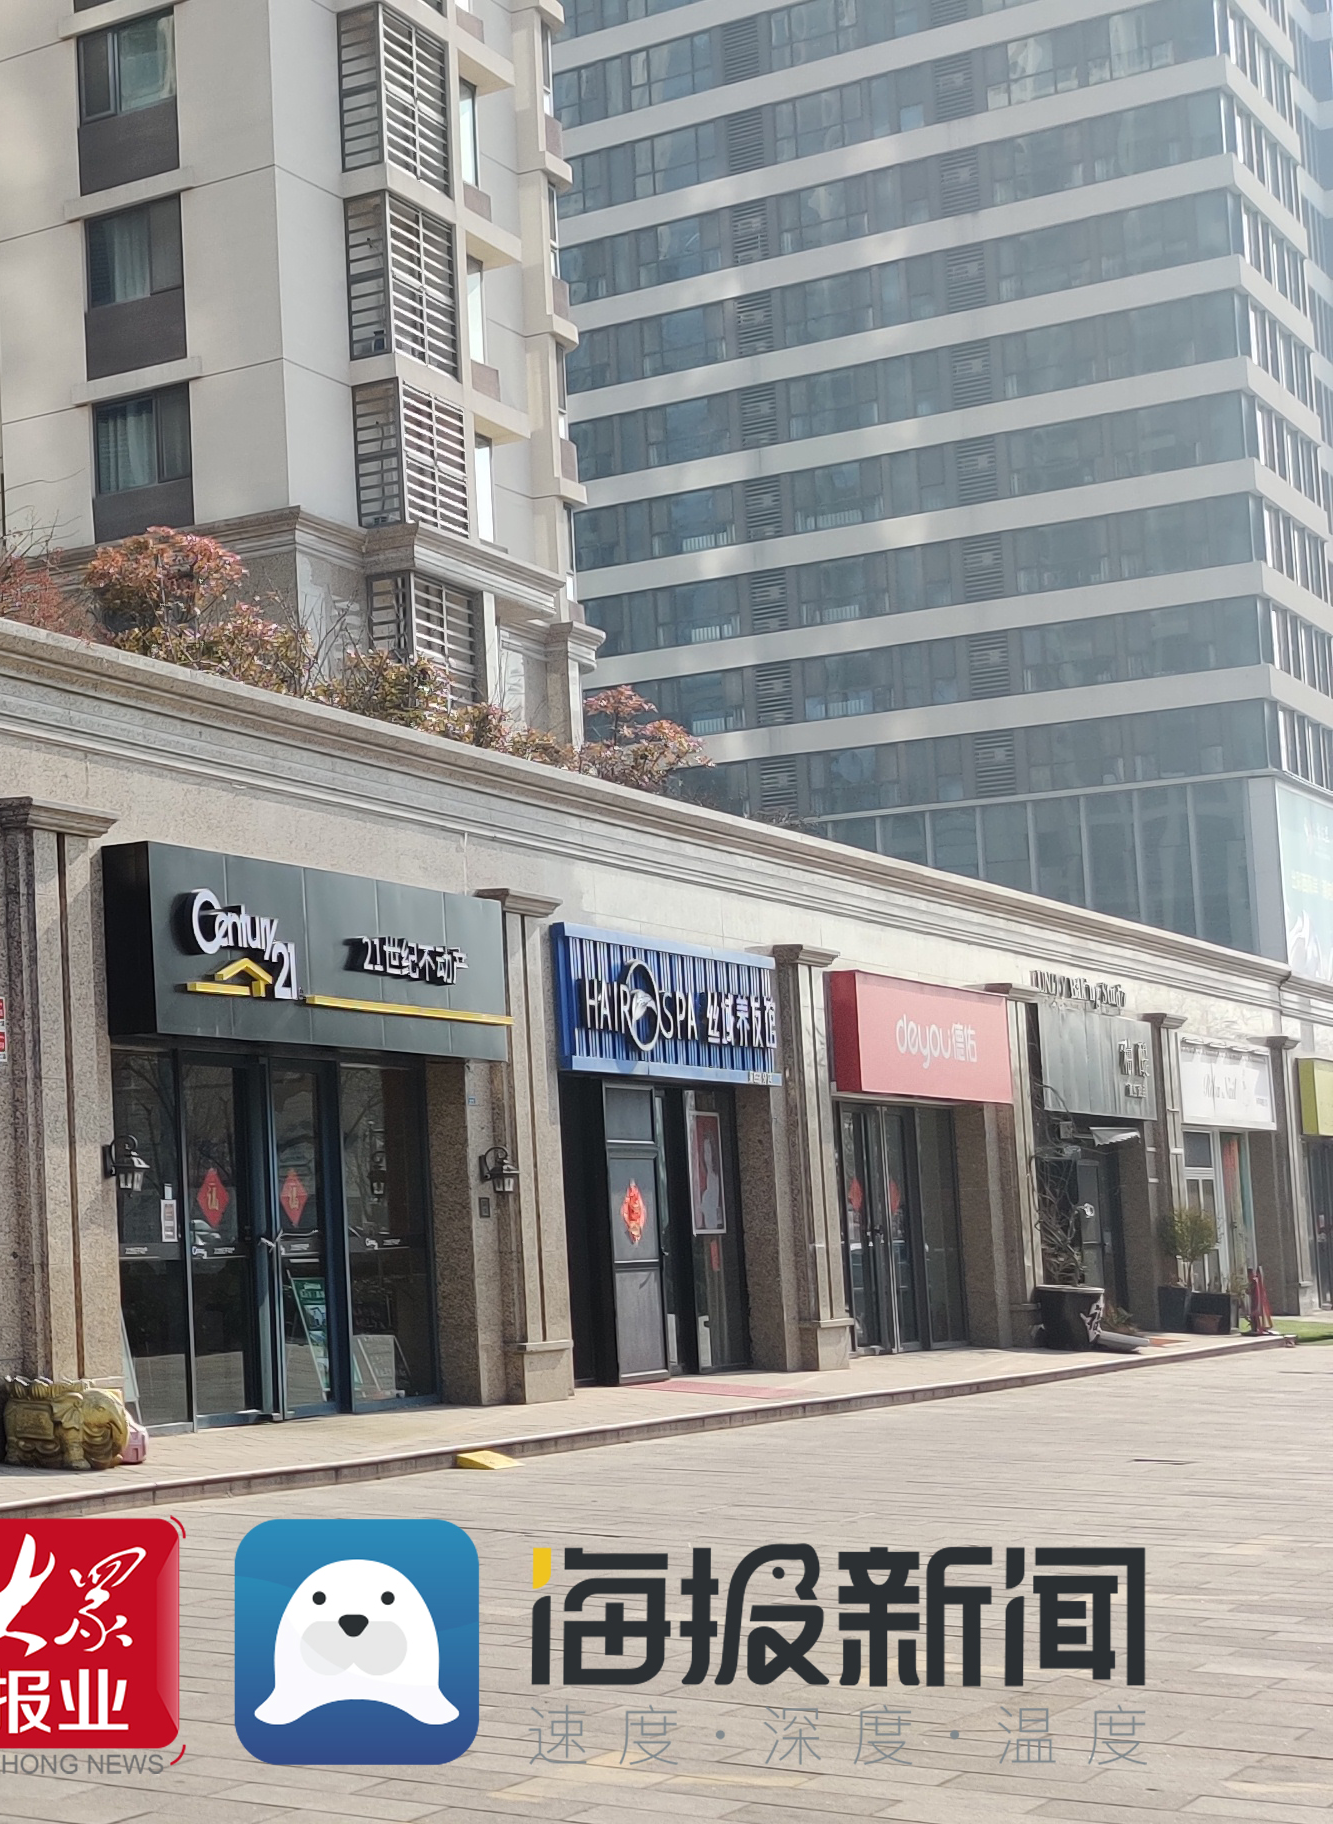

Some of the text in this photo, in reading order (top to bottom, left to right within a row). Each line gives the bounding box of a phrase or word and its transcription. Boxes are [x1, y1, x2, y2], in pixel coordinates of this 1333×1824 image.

[190, 887, 279, 960] Century
[271, 941, 298, 1000] 21
[359, 934, 469, 985] 21世纪不动产
[658, 990, 699, 1041] SPA
